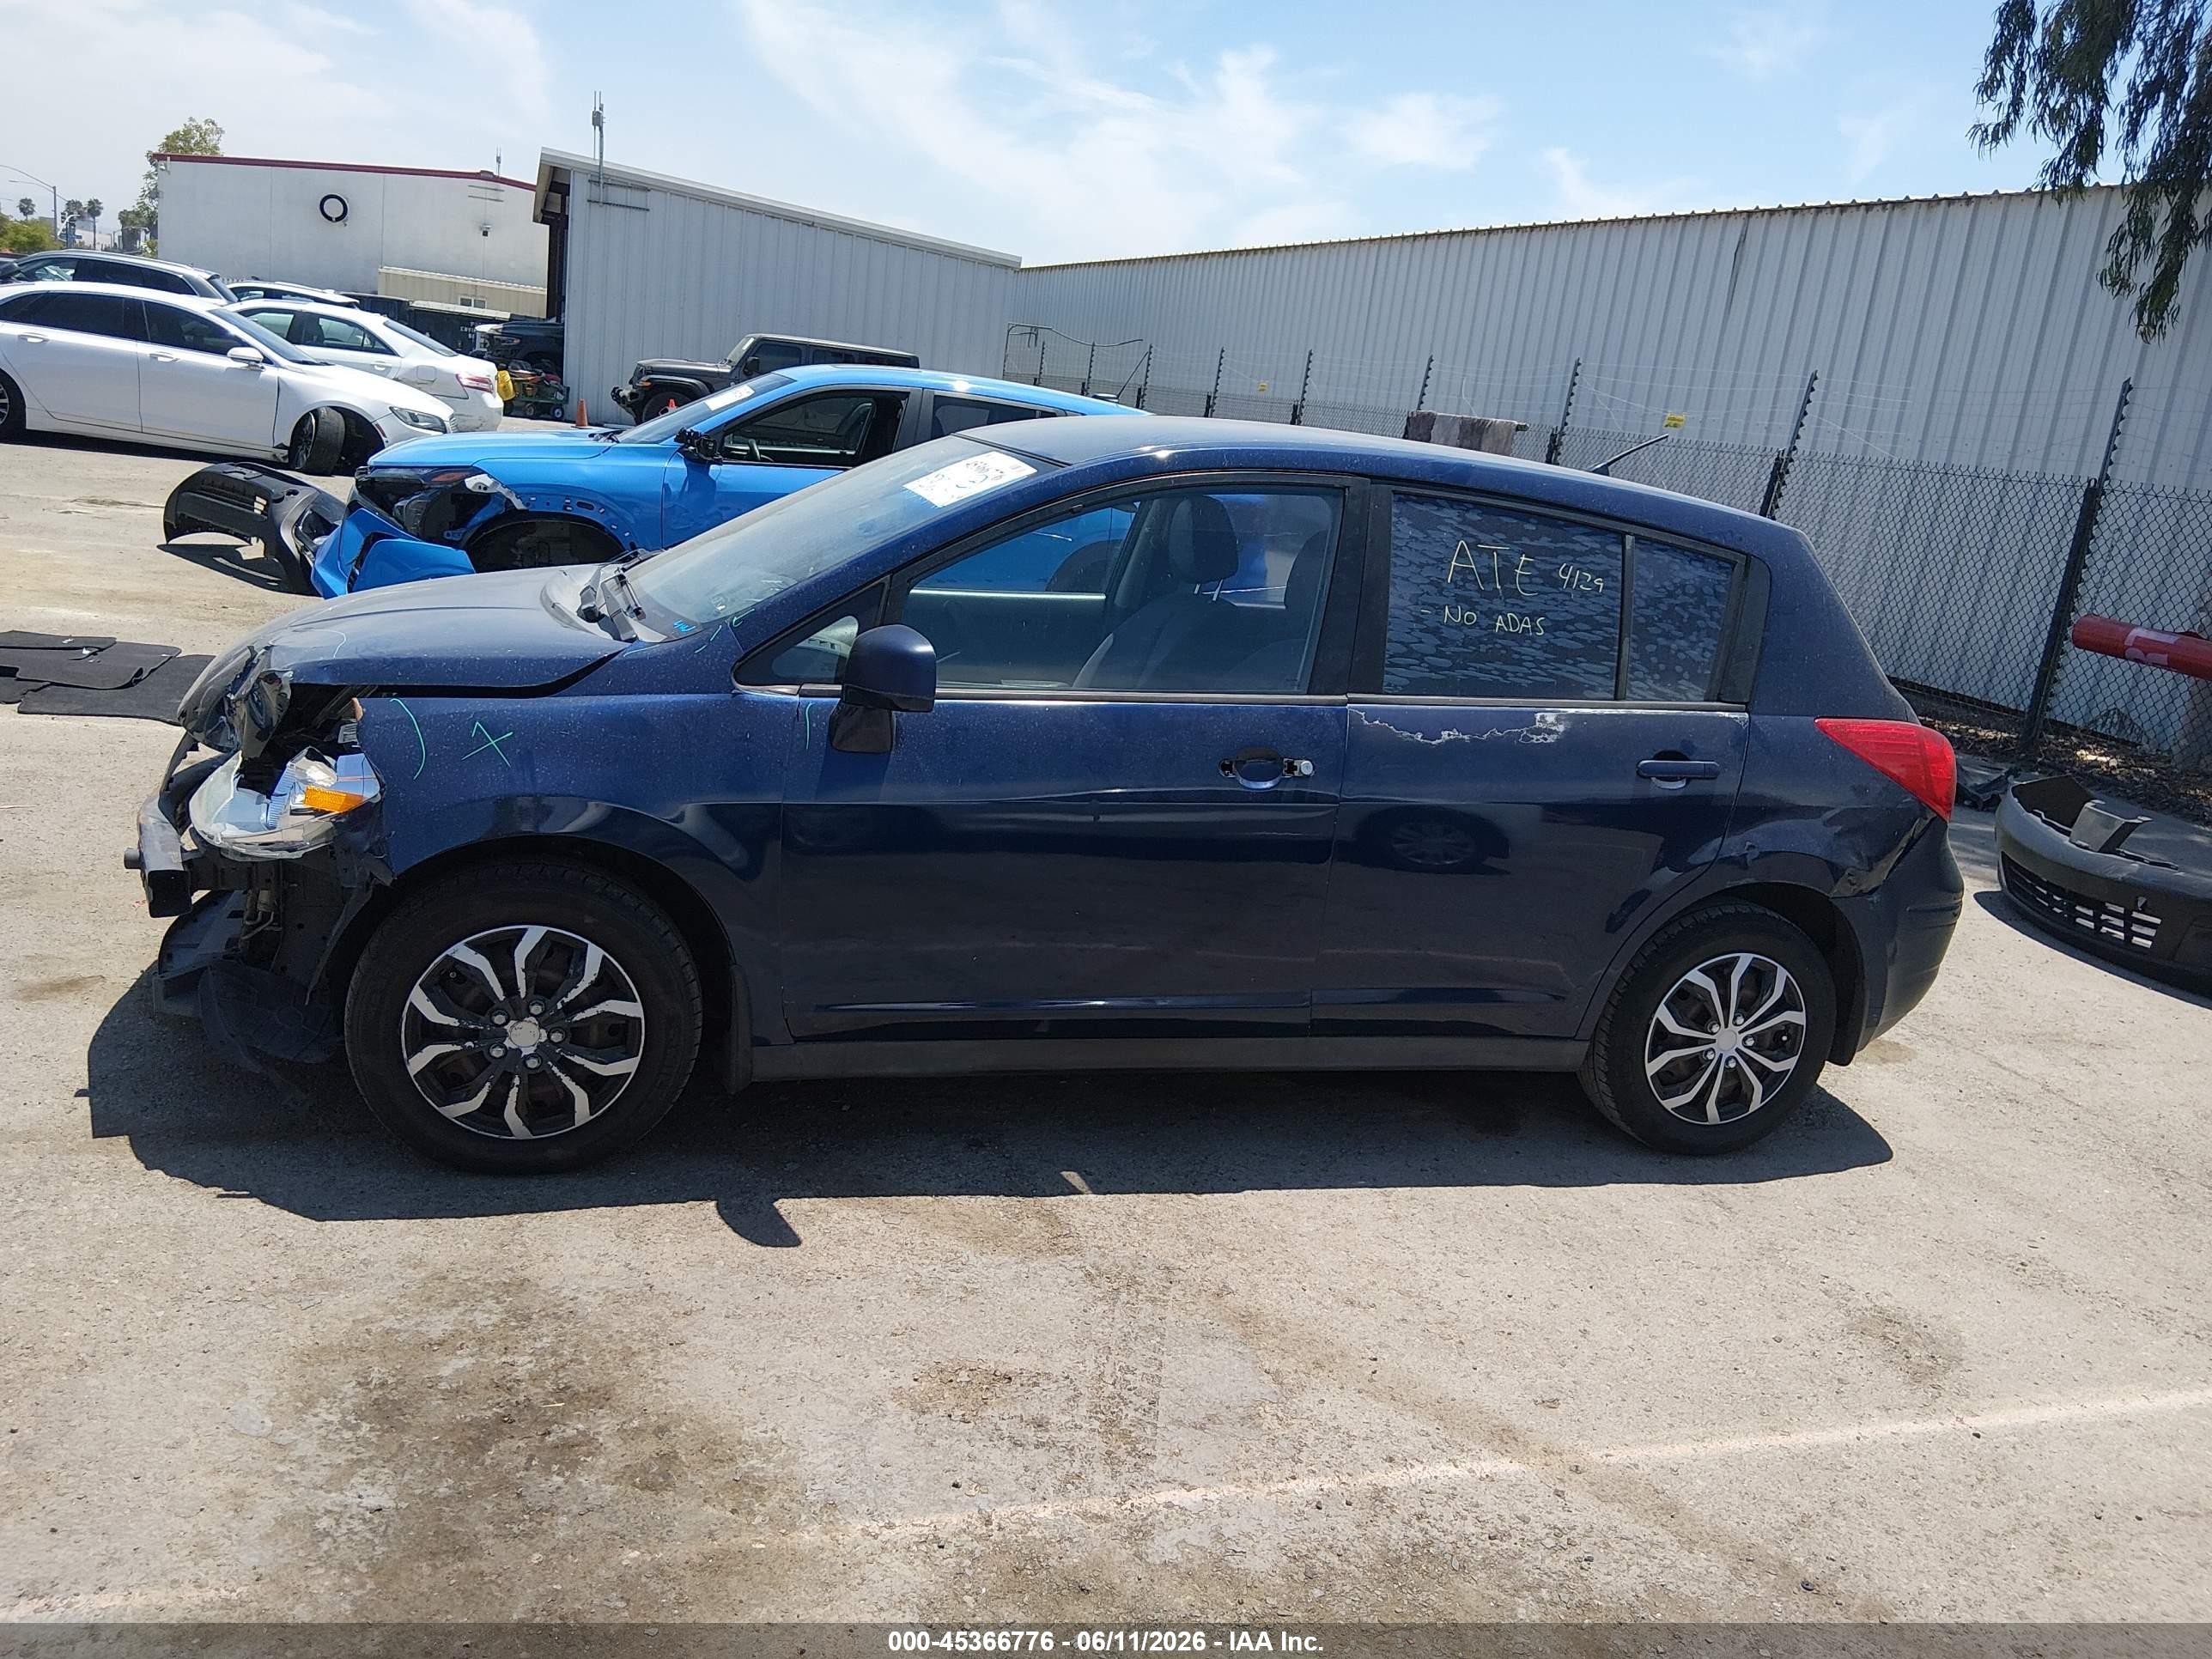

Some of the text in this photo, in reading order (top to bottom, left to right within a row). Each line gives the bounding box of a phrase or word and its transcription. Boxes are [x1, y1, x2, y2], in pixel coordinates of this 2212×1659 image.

[1447, 540, 1539, 596] ATE
[1443, 605, 1478, 626] NO
[1495, 612, 1546, 636] ADAS
